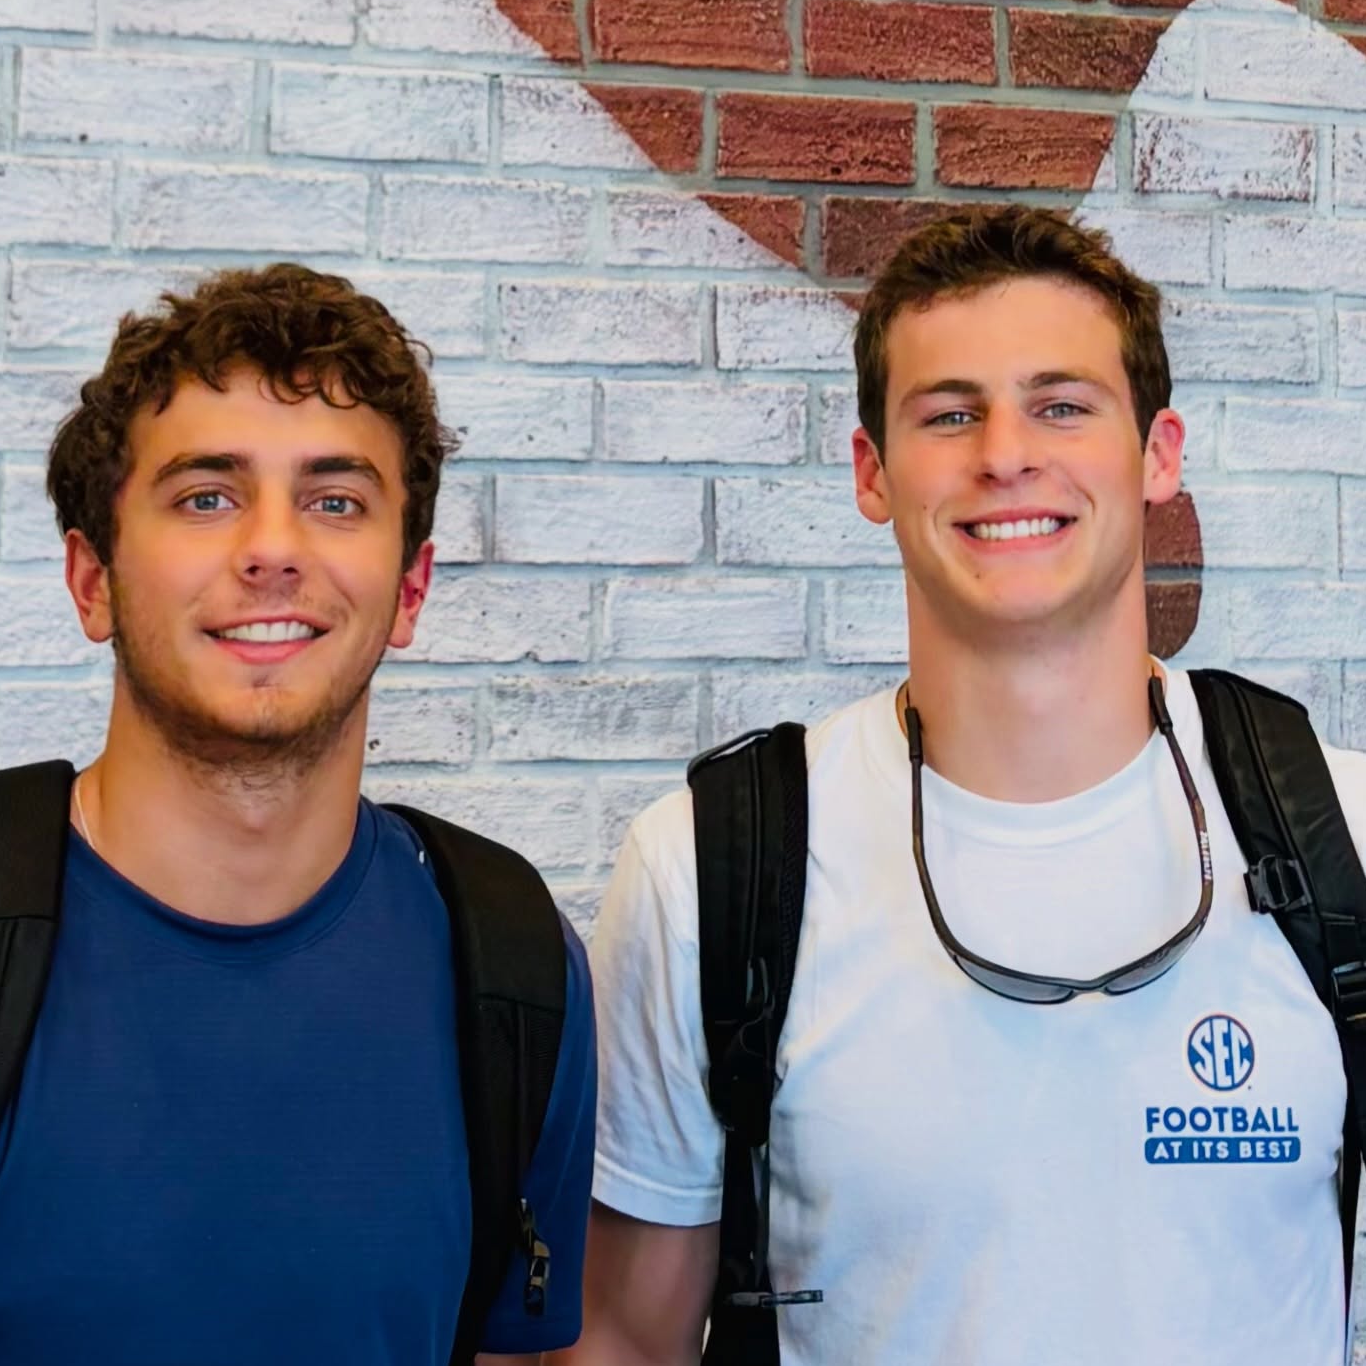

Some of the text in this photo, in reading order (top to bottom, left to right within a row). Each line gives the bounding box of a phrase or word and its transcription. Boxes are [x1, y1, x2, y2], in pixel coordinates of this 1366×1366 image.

[1190, 1017, 1252, 1088] SEC
[1145, 1106, 1300, 1133] FOOTBALL
[1153, 1140, 1293, 1159] AT ITS BEST
